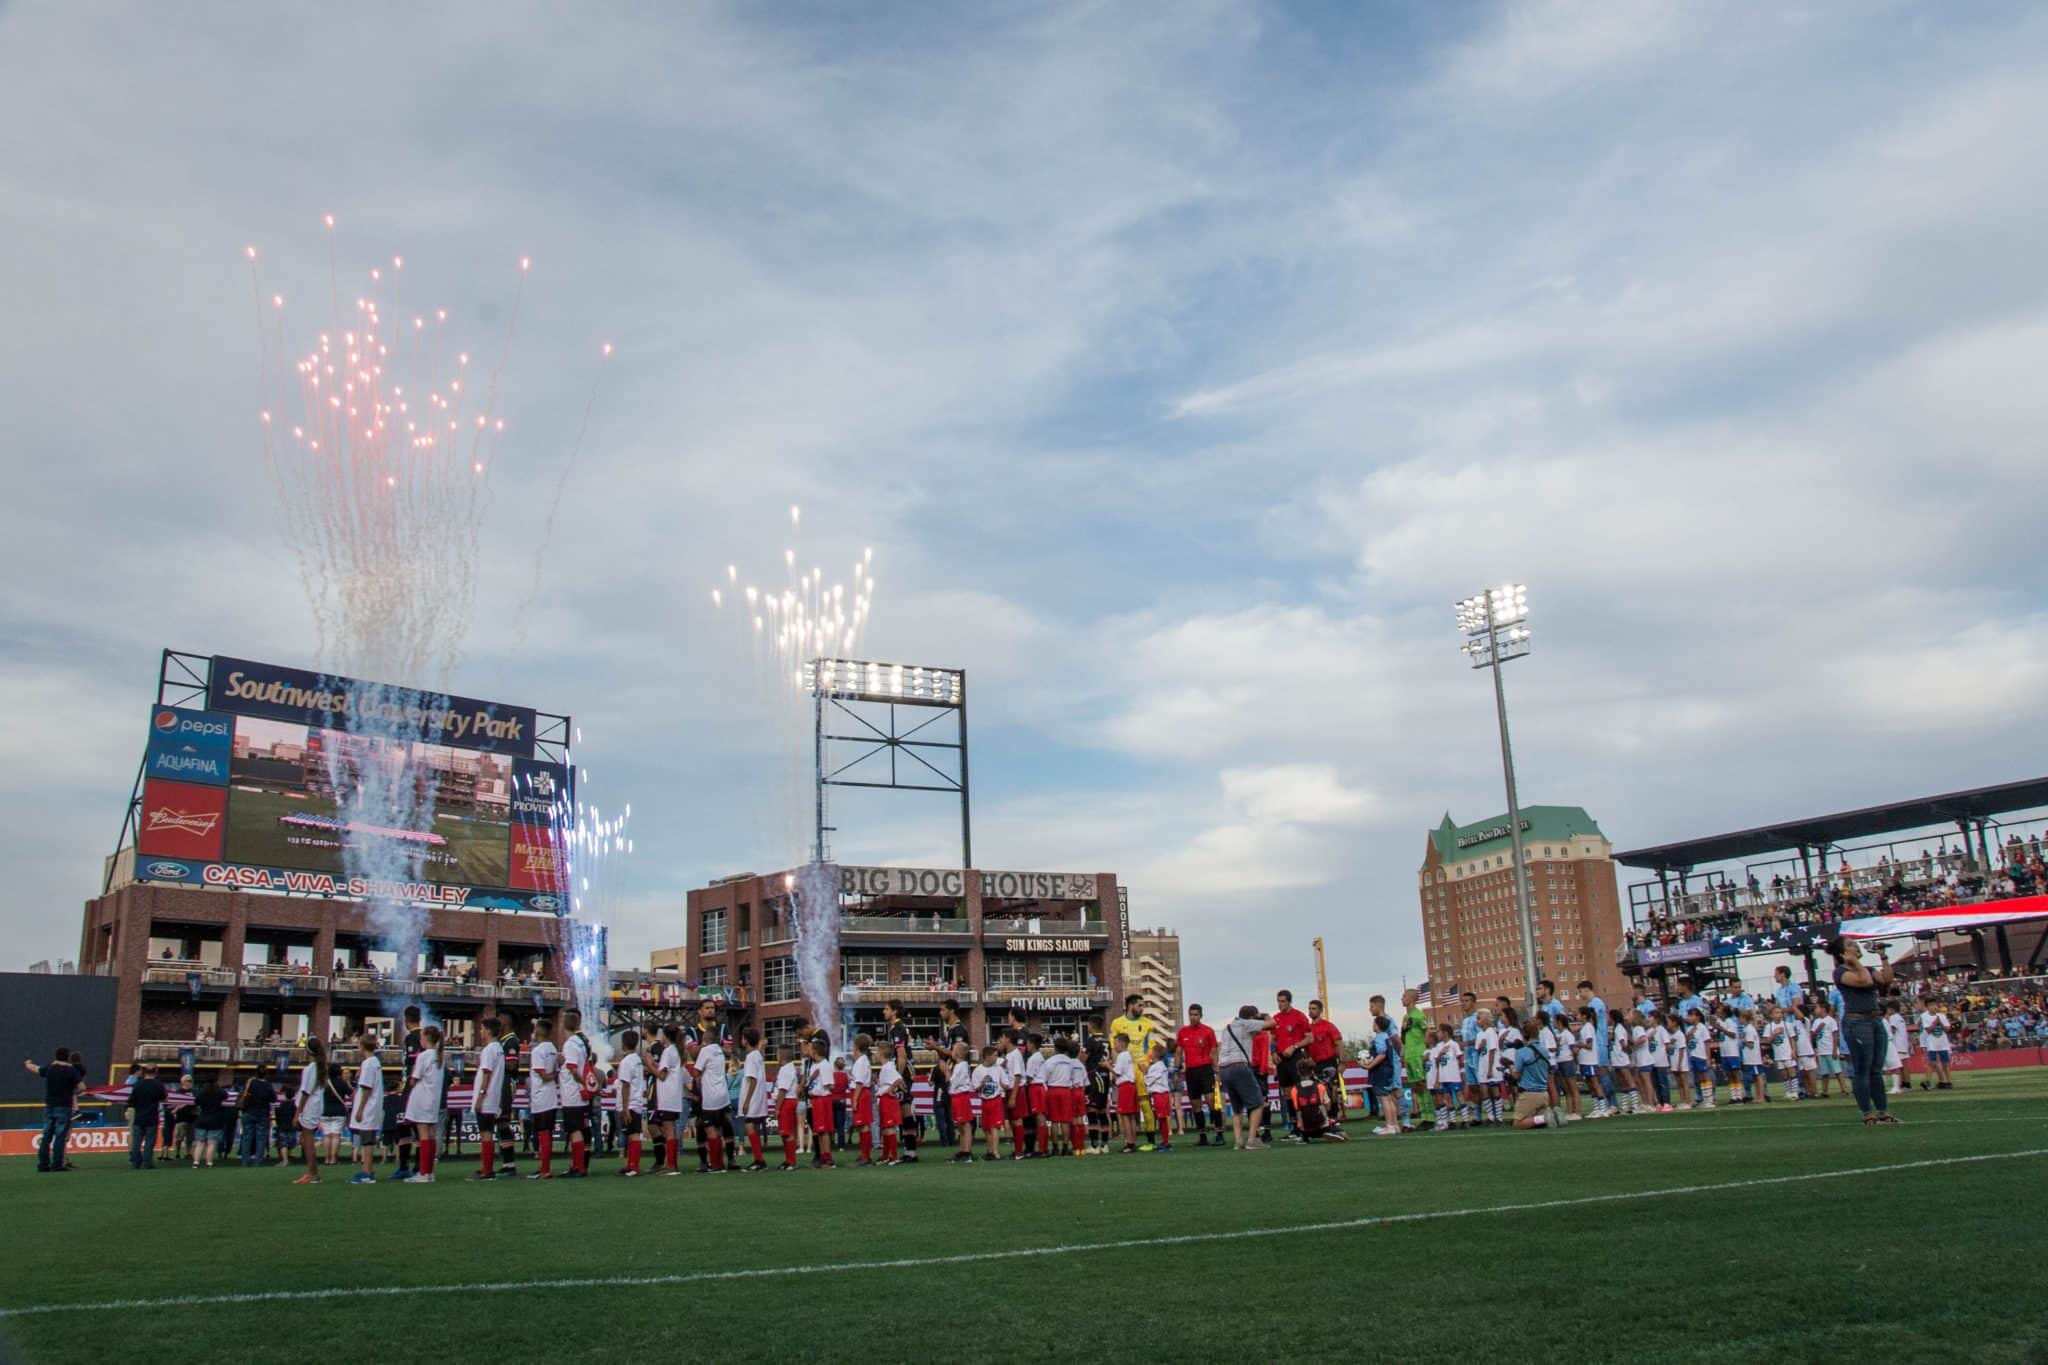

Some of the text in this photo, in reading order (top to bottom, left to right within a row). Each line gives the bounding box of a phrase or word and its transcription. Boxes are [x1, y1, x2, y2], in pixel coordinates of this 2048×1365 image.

[180, 720, 228, 736] pepsi
[472, 710, 524, 740] Park
[156, 753, 219, 776] AQUAFINA
[348, 878, 471, 904] SHAMALEY
[841, 868, 1065, 898] BIG DOG HOUSE
[1006, 938, 1090, 952] SUN KINGS SALOON
[1011, 997, 1093, 1011] CITY HALL GRILL
